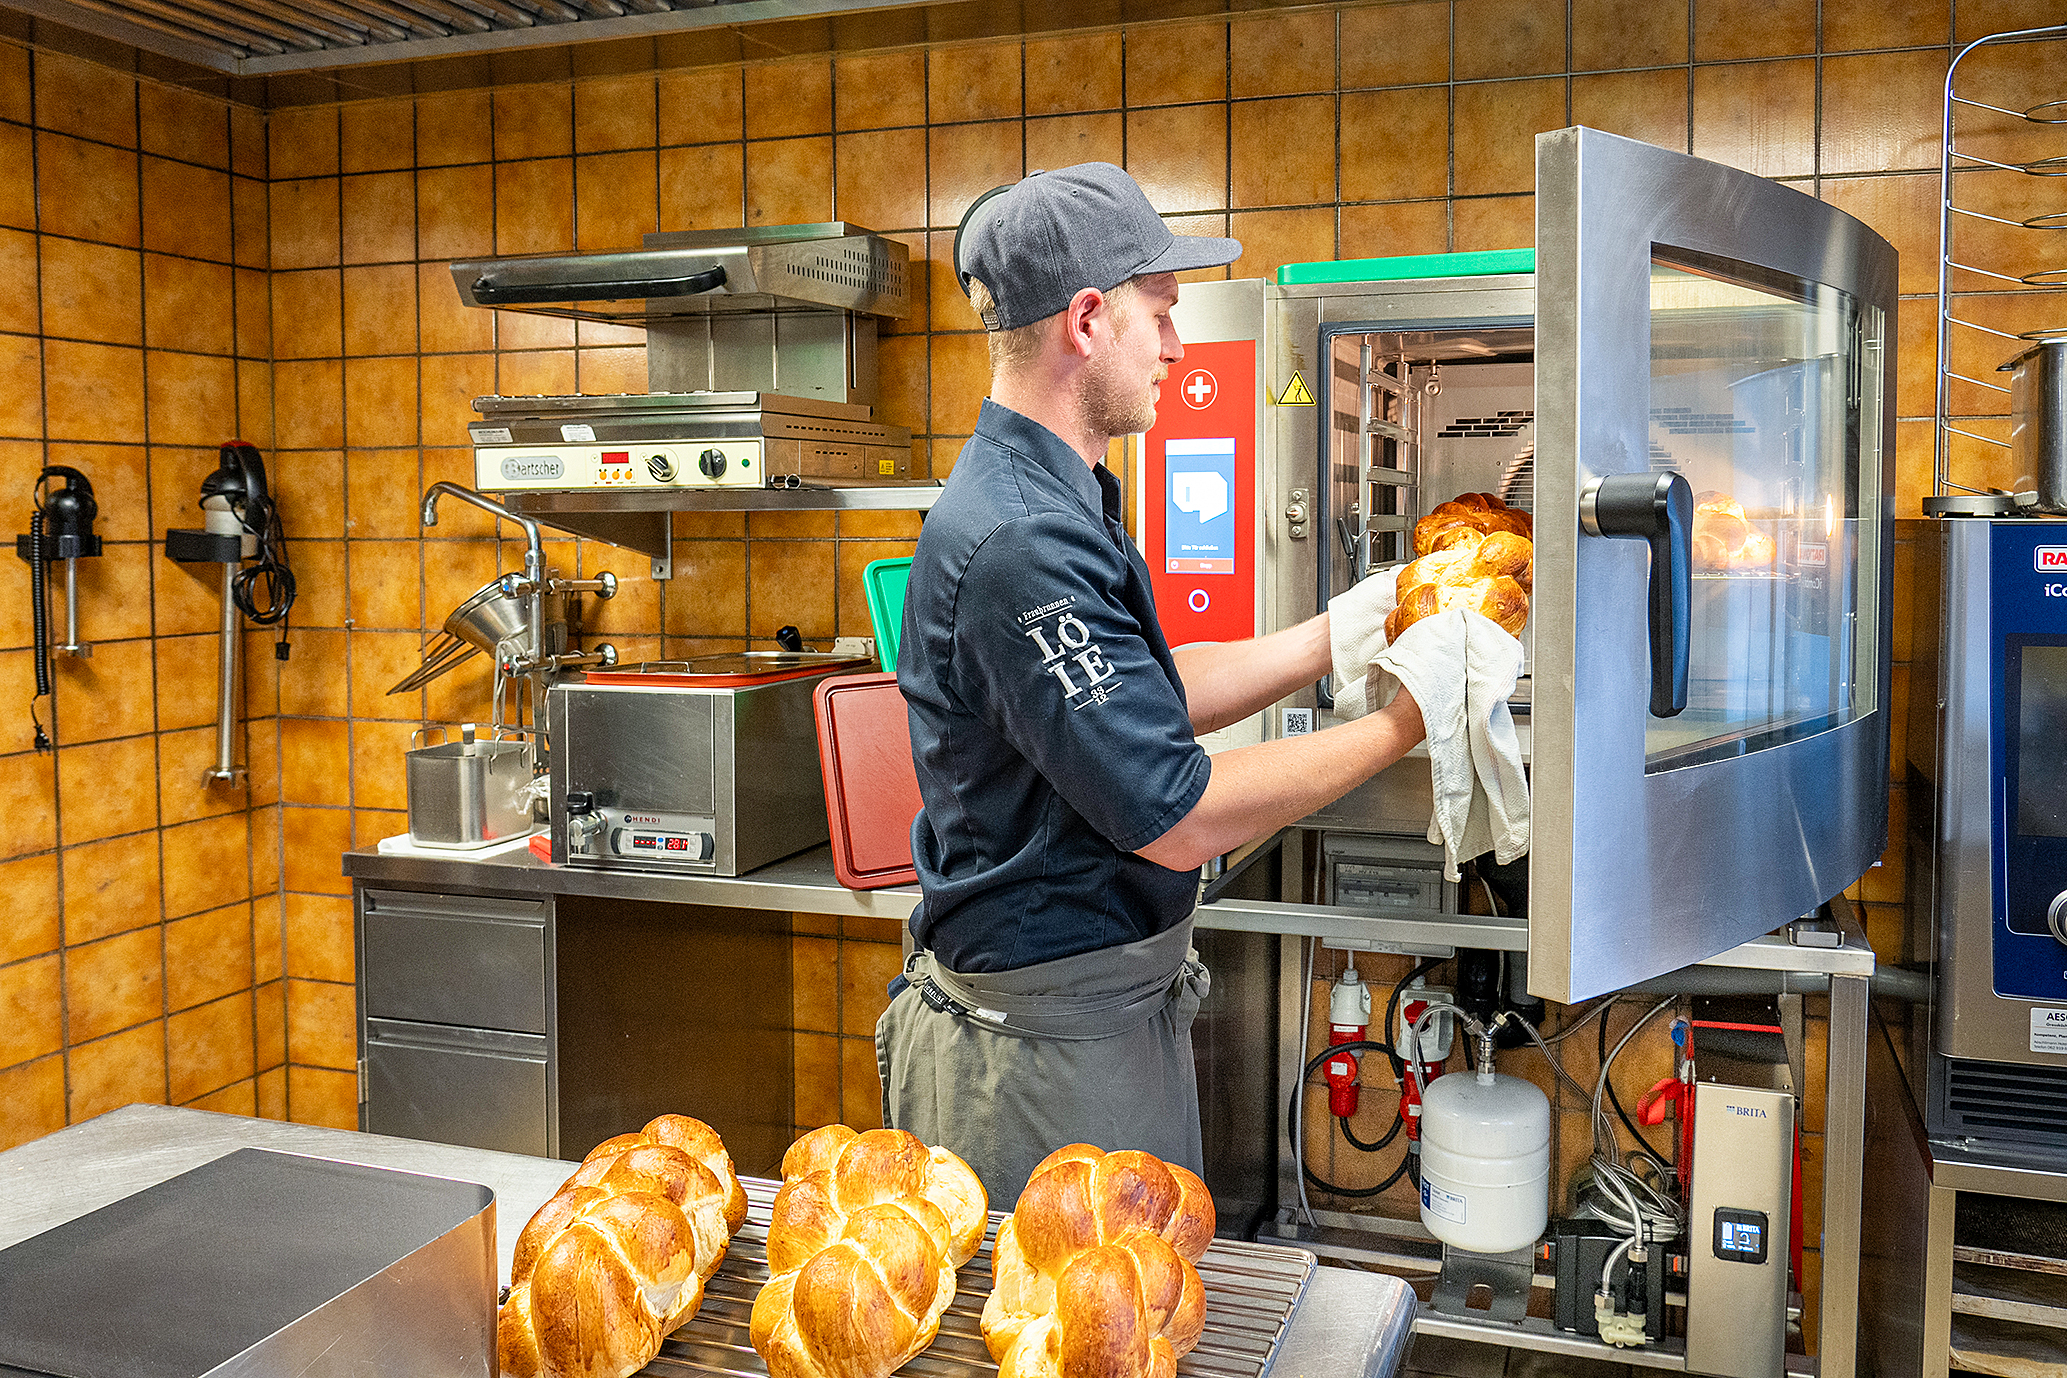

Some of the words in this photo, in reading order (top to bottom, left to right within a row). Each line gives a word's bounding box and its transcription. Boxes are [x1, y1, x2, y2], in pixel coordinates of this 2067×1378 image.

[633, 816, 660, 824] HENDI
[2046, 1012, 2067, 1022] AES
[1736, 1106, 1767, 1118] BRITA
